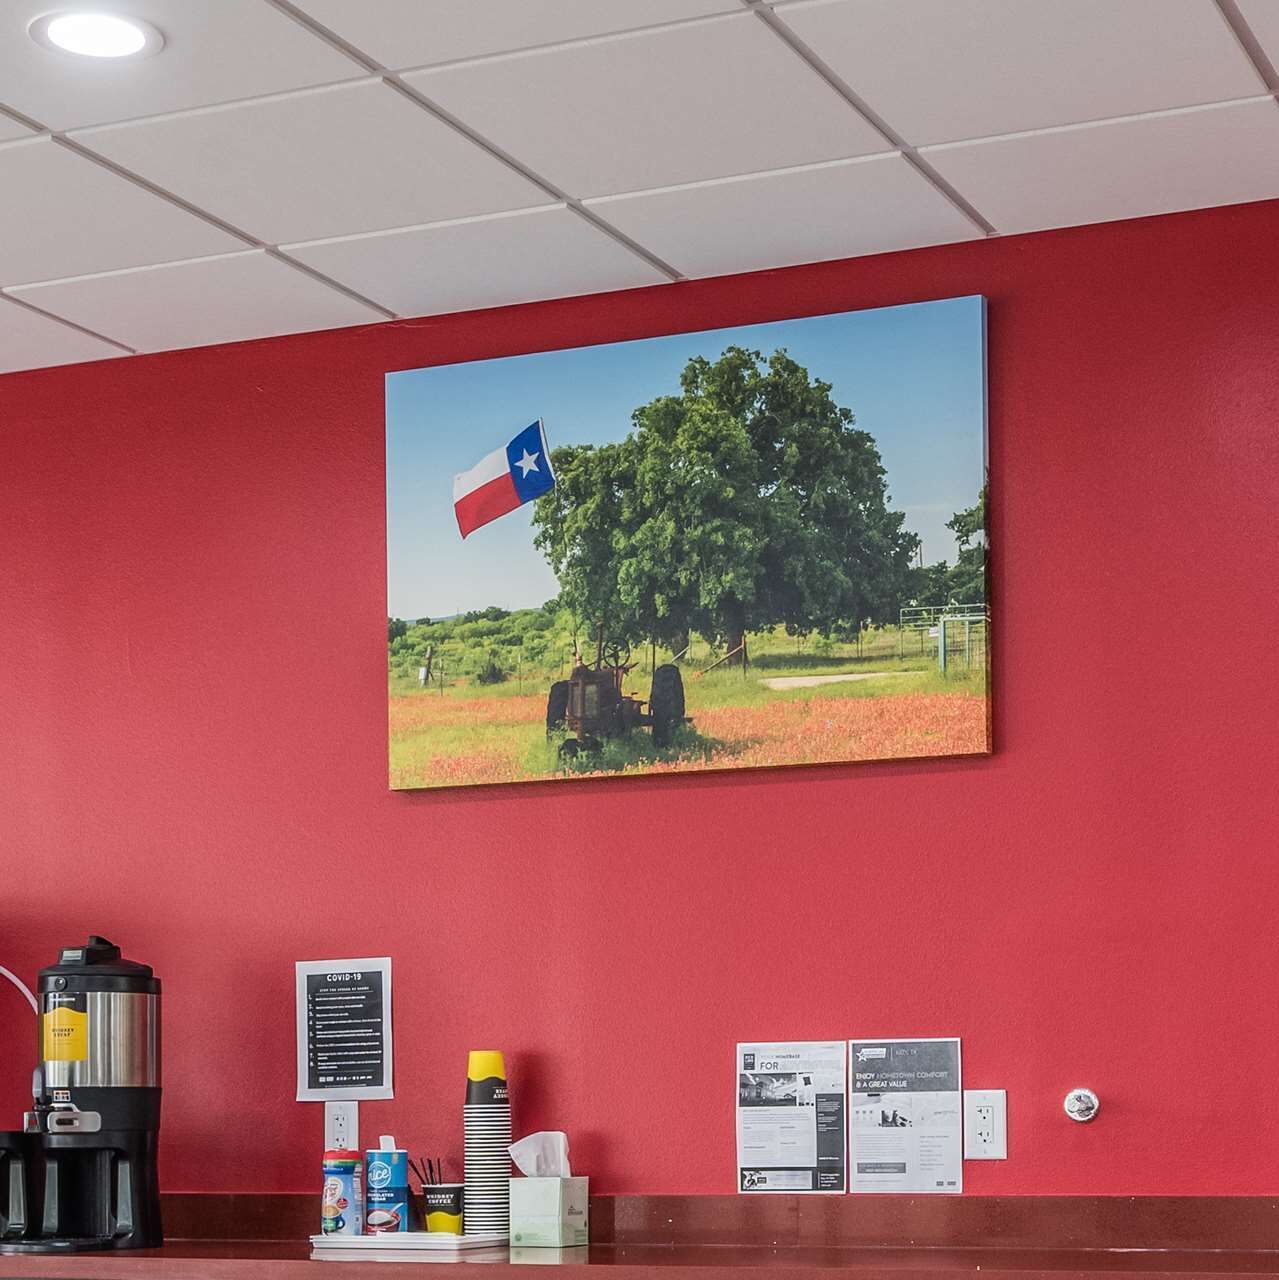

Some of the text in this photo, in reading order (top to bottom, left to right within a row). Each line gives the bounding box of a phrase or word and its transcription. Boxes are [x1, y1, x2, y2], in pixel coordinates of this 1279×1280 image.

[327, 973, 362, 982] COVID-19
[760, 1062, 779, 1070] FOR
[855, 1072, 875, 1080] ENJOY
[916, 1071, 948, 1079] COMFORT
[888, 1080, 908, 1088] VALUE
